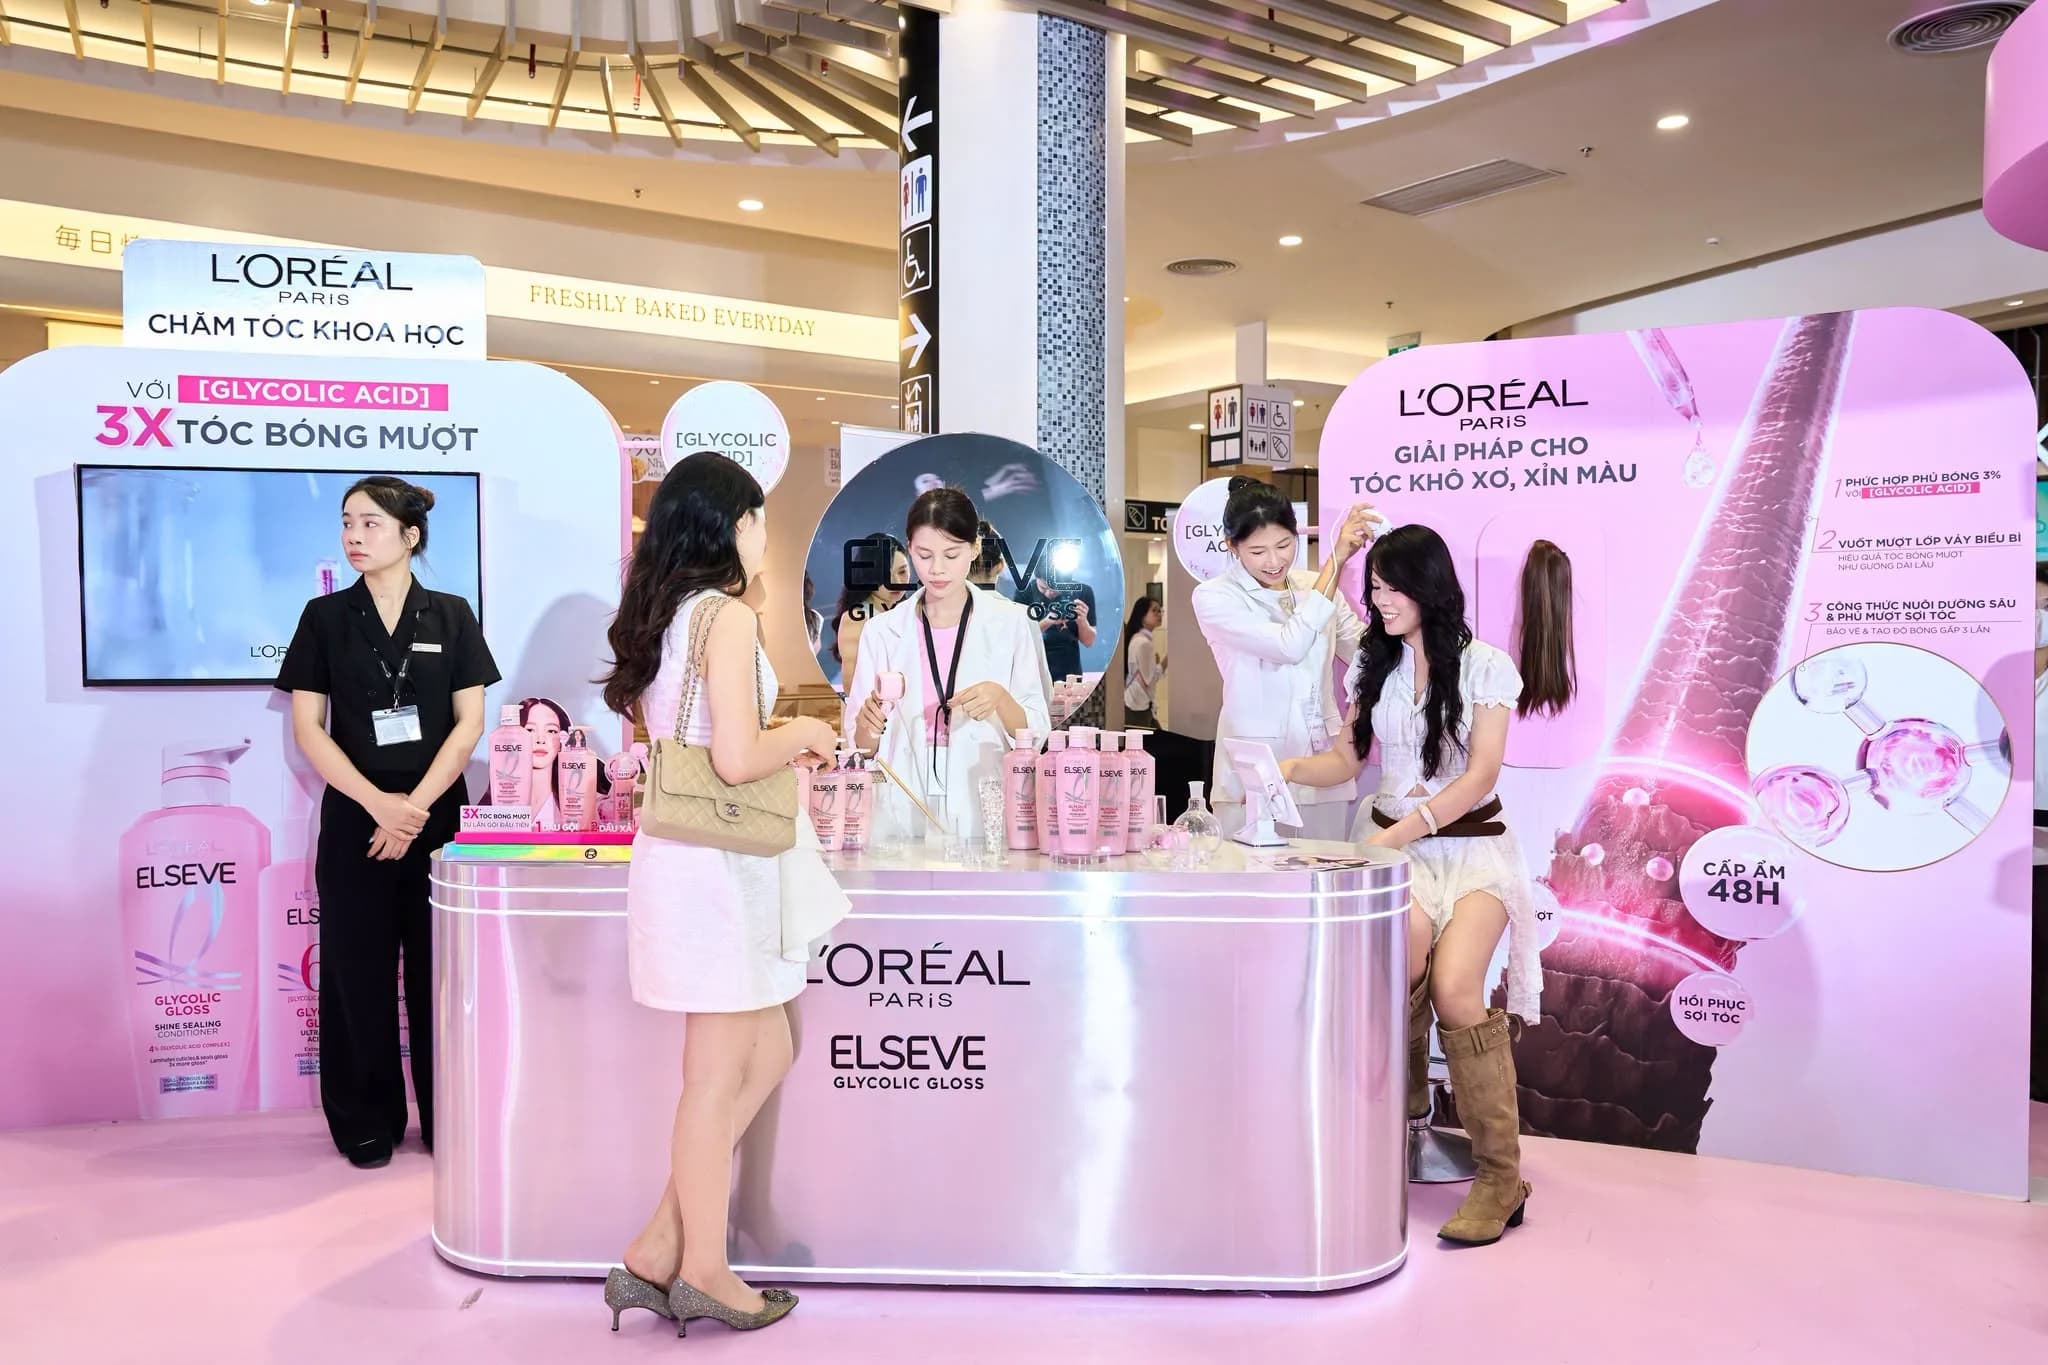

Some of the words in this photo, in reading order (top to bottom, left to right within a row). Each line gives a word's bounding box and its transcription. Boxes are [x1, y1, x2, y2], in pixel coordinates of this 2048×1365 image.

[211, 253, 413, 291] L'ORÉAL
[278, 291, 350, 306] PARIS
[529, 284, 627, 313] FRESHLY
[635, 297, 706, 323] BAKED
[714, 308, 816, 337] EVERYDAY
[148, 310, 235, 337] CHĂM
[243, 314, 304, 338] TÓC
[313, 319, 395, 343] KHOA
[404, 324, 464, 349] HỌC
[126, 378, 171, 400] VỚI
[199, 379, 345, 404] [GLYCOLIC
[354, 385, 429, 409] ACID]
[1399, 378, 1589, 417] L'ORÉAL
[95, 405, 176, 448] 3X
[177, 414, 254, 446] TÓC
[265, 418, 368, 448] BÓNG
[379, 422, 479, 455] MƯỢT
[676, 432, 777, 448] [GLYCOLIC
[1394, 440, 1446, 464] GIẢI
[1454, 437, 1523, 461] PHÁP
[1530, 436, 1589, 457] CHO
[1350, 472, 1402, 494] TÓC
[1409, 468, 1464, 492] KHÔ
[1472, 467, 1517, 492] XƠ,
[1523, 462, 1568, 487] XỈN
[1577, 460, 1637, 485] MÀU
[1845, 476, 1879, 487] PHỨC
[1882, 474, 1909, 486] HỢP
[1912, 472, 1938, 484] PHỦ
[1941, 471, 1979, 482] BÓNG
[1983, 470, 2001, 480] 3%
[1818, 530, 1837, 550] 2
[1876, 536, 1913, 548] MƯỢT
[1916, 535, 1941, 546] LỚP
[1804, 602, 1822, 622] 3
[1826, 602, 1863, 611] CÔNG
[1865, 600, 1899, 611] THỨC
[1826, 613, 1835, 622] &
[1865, 611, 1901, 622] MƯỢT
[1905, 611, 1928, 622] SỢI
[1931, 609, 1956, 620] TÓC
[494, 744, 522, 752] ELSEVE
[1012, 766, 1036, 774] ELSEV
[1064, 766, 1092, 774] ELSEVE
[812, 784, 838, 792] ELSEVE
[462, 807, 479, 820] 3X
[136, 862, 237, 889] ELSEVE
[1703, 858, 1746, 877] CẤP
[1753, 859, 1785, 880] ẨM
[1707, 878, 1779, 905] 48H
[286, 908, 320, 926] ELS
[154, 992, 221, 1006] GLYCOLIC
[1707, 998, 1746, 1011] PHỤC
[165, 1004, 210, 1016] GLOSS
[1684, 1010, 1707, 1022] SỢI
[1711, 1011, 1740, 1024] TÓC
[154, 1022, 180, 1031] SHINE
[182, 1020, 222, 1030] SEALING
[157, 1028, 219, 1039] CONDITIONER
[831, 1035, 986, 1070] ELSEVE
[833, 1076, 920, 1090] GLYCOLIC
[927, 1076, 984, 1090] GLOSS
